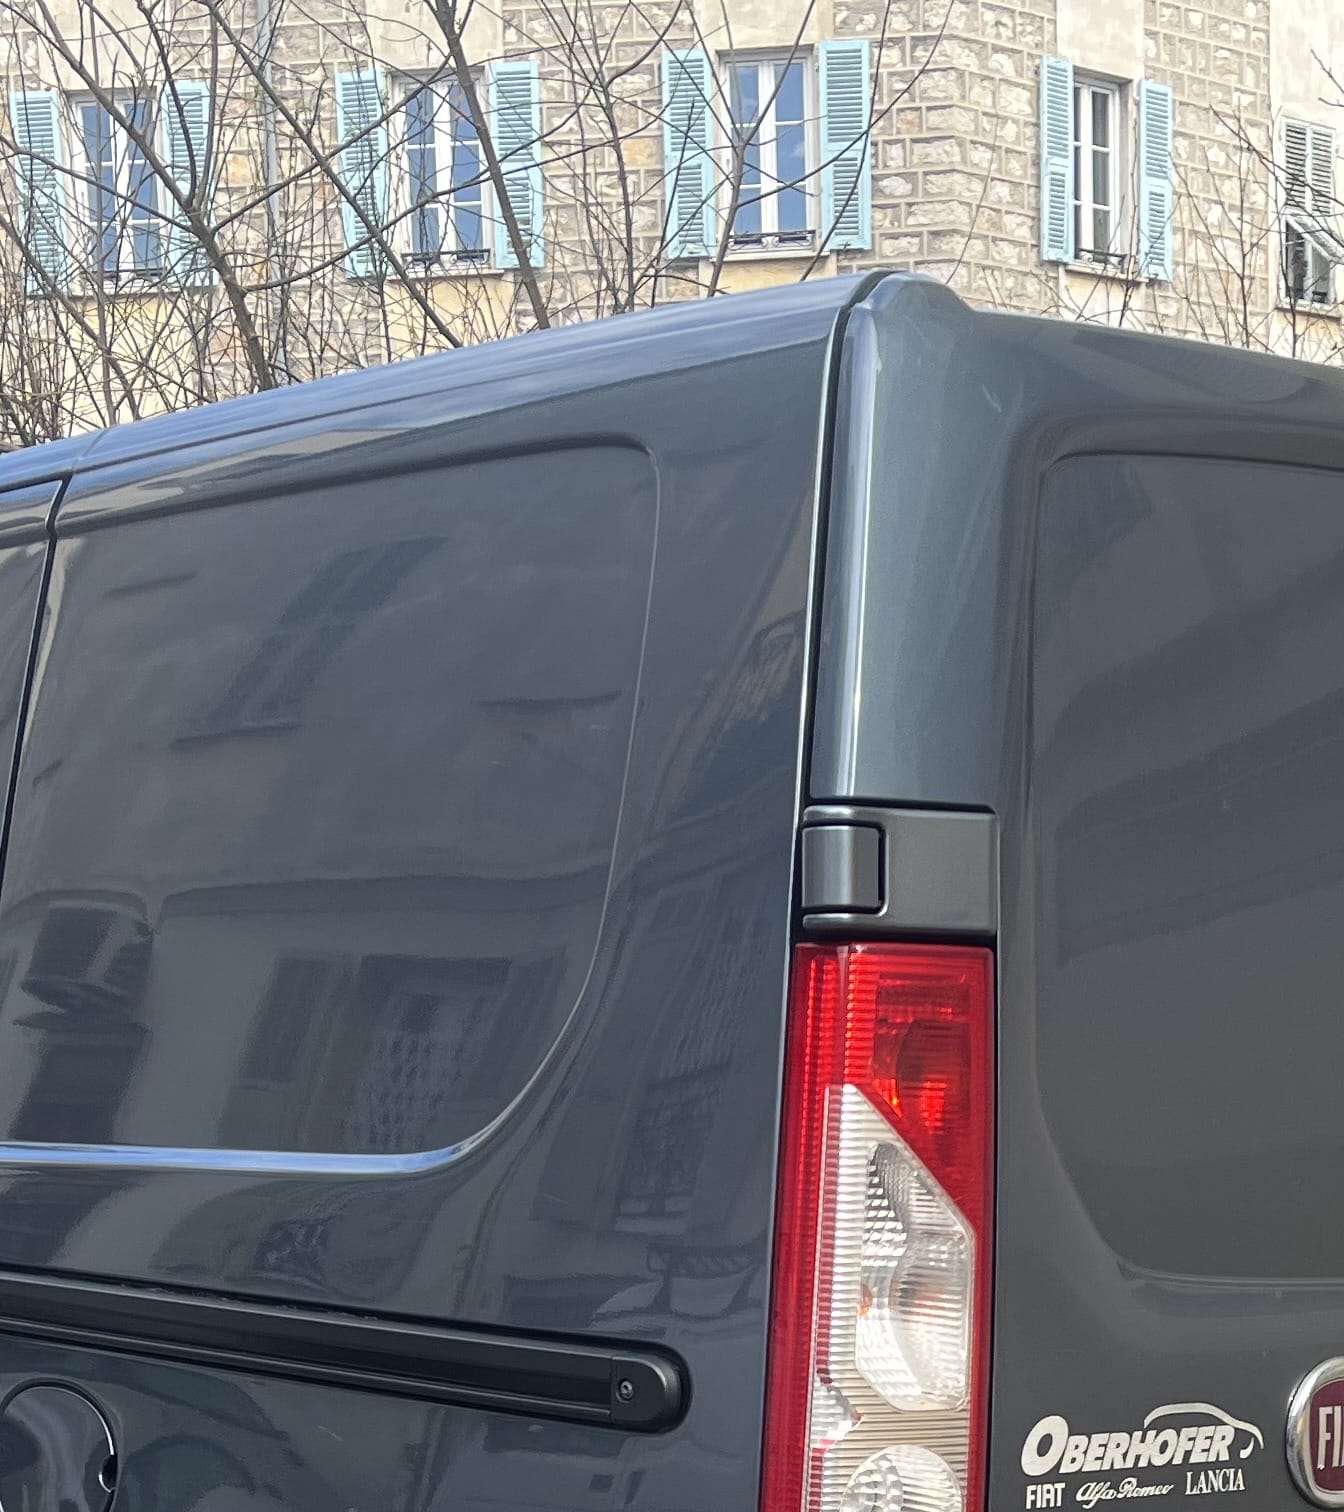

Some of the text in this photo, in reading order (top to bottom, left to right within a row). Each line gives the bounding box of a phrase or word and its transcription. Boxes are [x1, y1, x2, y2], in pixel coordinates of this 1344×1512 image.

[1025, 1468, 1246, 1510] FIAT Alfa Romeo LANCIA
